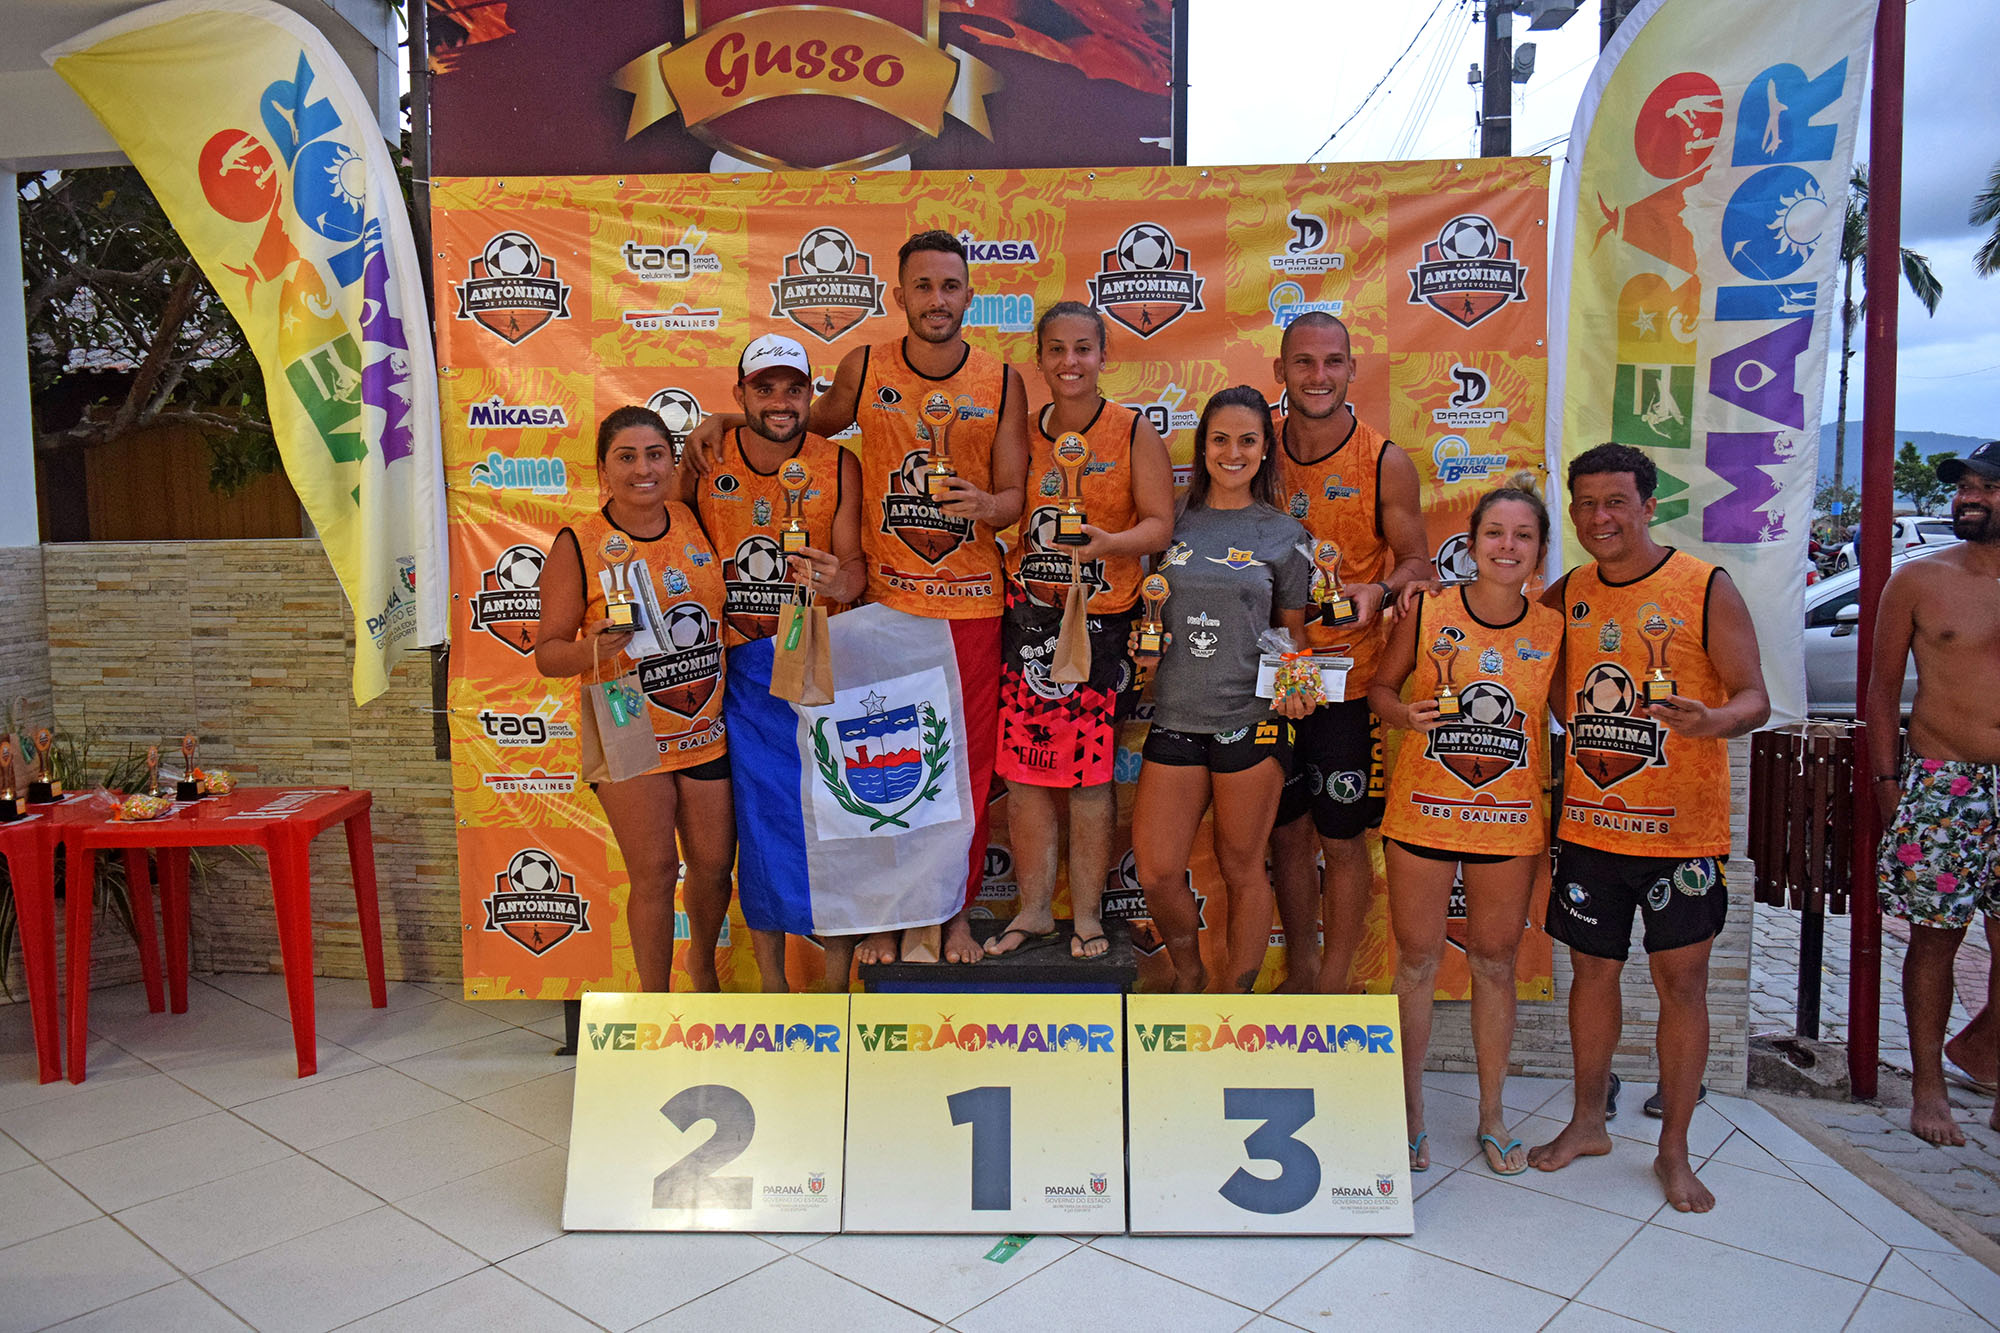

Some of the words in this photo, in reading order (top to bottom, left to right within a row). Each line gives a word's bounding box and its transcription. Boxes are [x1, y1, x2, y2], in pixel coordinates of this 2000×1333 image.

[705, 32, 905, 97] Gusso
[623, 243, 690, 278] tag
[693, 256, 715, 264] smart
[963, 243, 1036, 261] IKASA
[1273, 257, 1341, 266] DRAGON
[1423, 268, 1513, 285] ANTONINA
[470, 286, 557, 301] ANTONINA
[784, 282, 872, 298] ANTONINA
[1102, 279, 1190, 295] ANTONINA
[1702, 56, 1849, 545] MAIOR
[635, 320, 657, 328] SES
[665, 319, 715, 328] SALINES
[470, 404, 565, 425] MIKASA
[1436, 411, 1504, 420] DRAGON
[489, 453, 565, 488] Samae
[1446, 465, 1488, 481] BRASIL
[925, 585, 992, 596] SALINES
[483, 598, 541, 613] ANTON
[643, 652, 718, 683] ANTONINA
[480, 712, 547, 744] tag
[1437, 732, 1520, 751] ANTONINA
[1019, 746, 1058, 769] EDGE
[1422, 805, 1451, 818] SES
[1461, 810, 1528, 823] SALINES
[1593, 813, 1669, 834] SALINES
[497, 901, 577, 915] ANTONINA
[1570, 907, 1598, 925] News
[652, 1084, 756, 1210] 2
[946, 1086, 1011, 1210] 1
[1218, 1087, 1322, 1214] 3
[762, 1184, 804, 1194] PARANÁ
[1045, 1184, 1087, 1195] PARANÁ
[1332, 1185, 1373, 1196] PARANÁ
